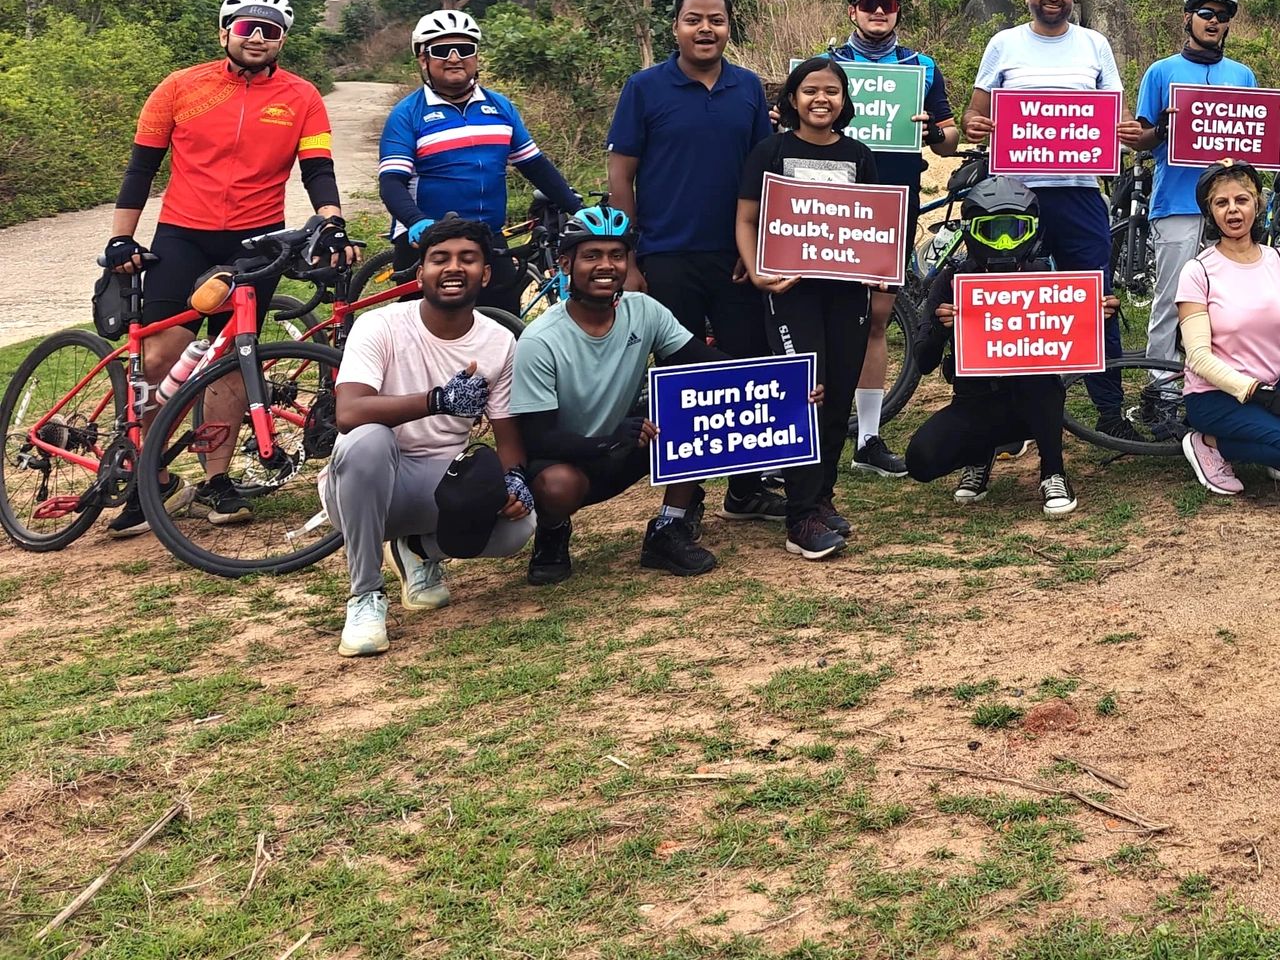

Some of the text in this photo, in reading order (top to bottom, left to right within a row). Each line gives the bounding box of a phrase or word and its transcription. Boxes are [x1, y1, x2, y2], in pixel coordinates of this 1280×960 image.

[847, 75, 897, 97] ycle
[854, 99, 901, 122] ndly
[1020, 101, 1094, 117] Wanna
[1191, 101, 1268, 119] CYCLING
[844, 122, 893, 141] nchi
[1012, 122, 1101, 140] bike ride
[1191, 118, 1266, 136] CLIMATE
[1008, 145, 1102, 163] with me?
[1192, 135, 1262, 153] JUSTICE
[790, 197, 874, 220] When in
[768, 218, 895, 246] doubt, pedal
[802, 242, 861, 264] it out.
[972, 284, 1087, 310] Every Ride
[984, 312, 1075, 335] is a Tiny
[778, 324, 797, 355] ORTS
[986, 336, 1073, 361] Holiday
[681, 379, 786, 409] Burn fat,
[693, 402, 776, 432] not oil.
[666, 424, 804, 461] Let's Pedal.
